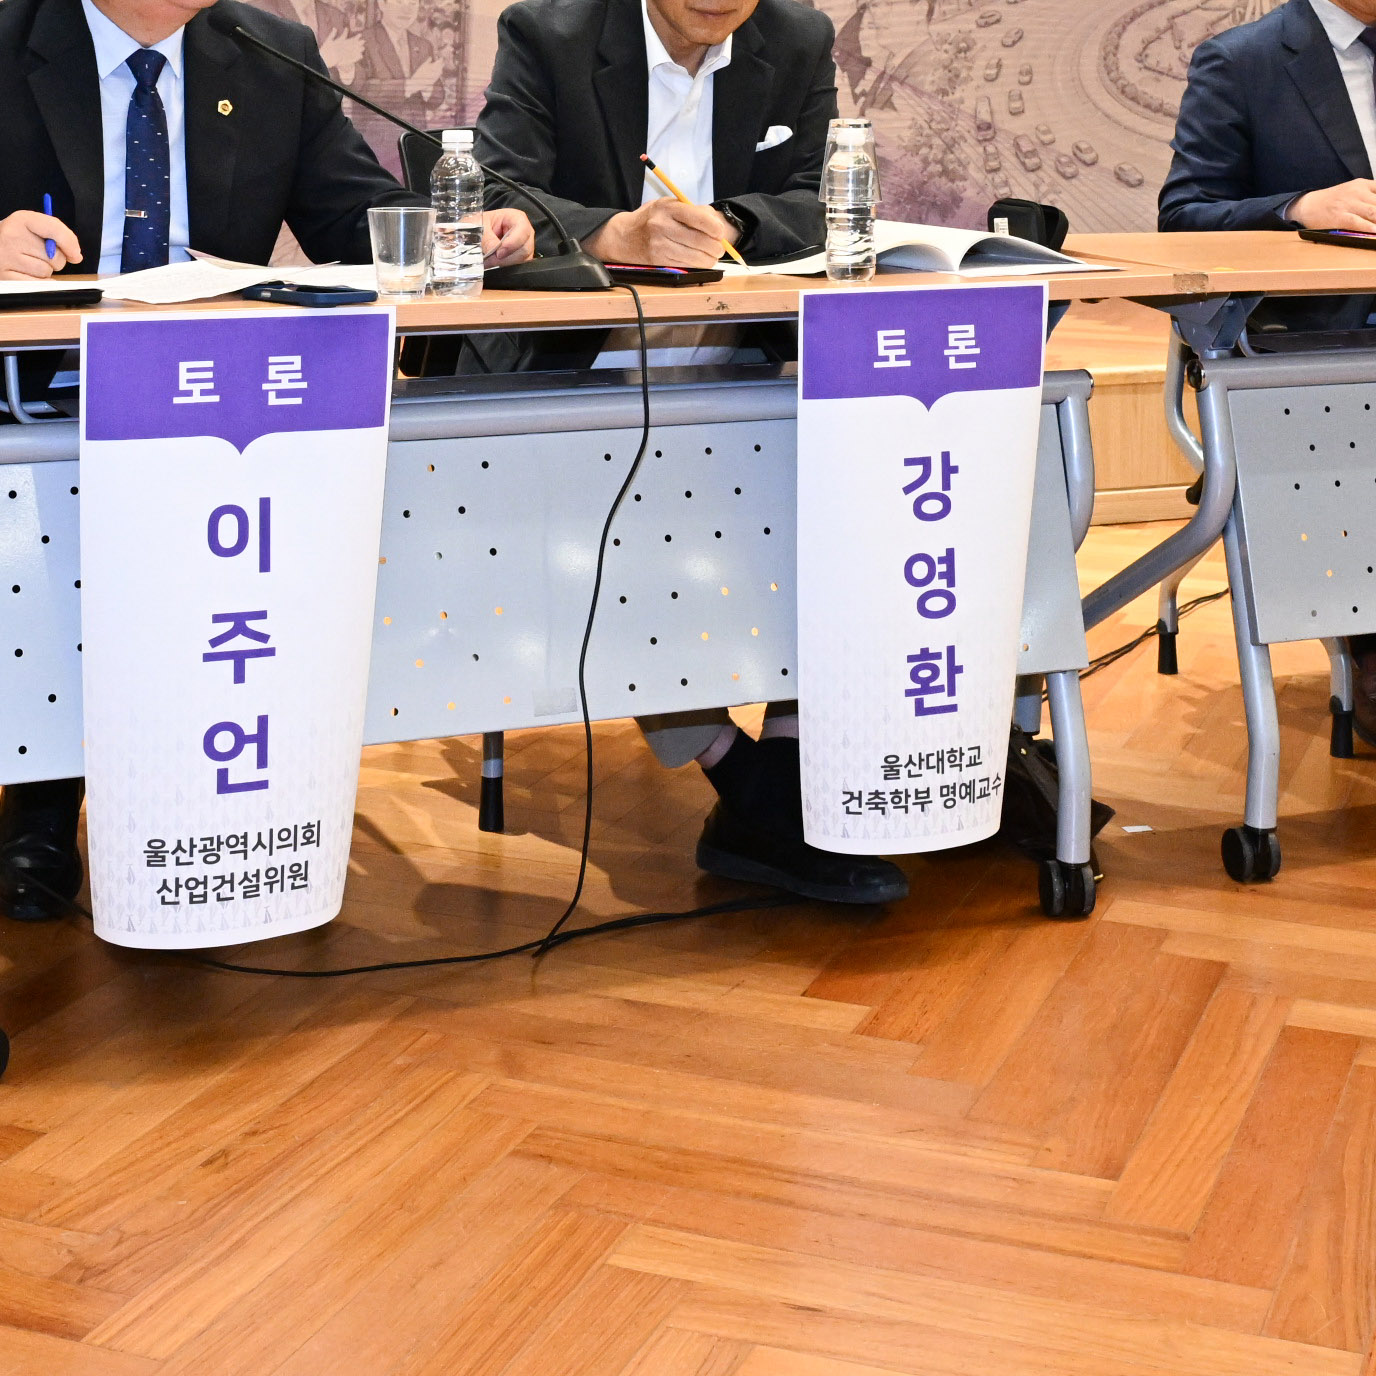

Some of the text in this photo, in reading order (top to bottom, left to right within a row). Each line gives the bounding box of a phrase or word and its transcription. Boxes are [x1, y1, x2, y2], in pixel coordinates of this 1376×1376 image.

[901, 451, 964, 718] 강영환
[202, 496, 276, 795] 이주언
[880, 745, 983, 780] 울산대학교
[841, 774, 1002, 817] 건축학부 명예교수
[143, 820, 321, 867] 울산광역시의회
[156, 860, 309, 906] 산업건설위원
